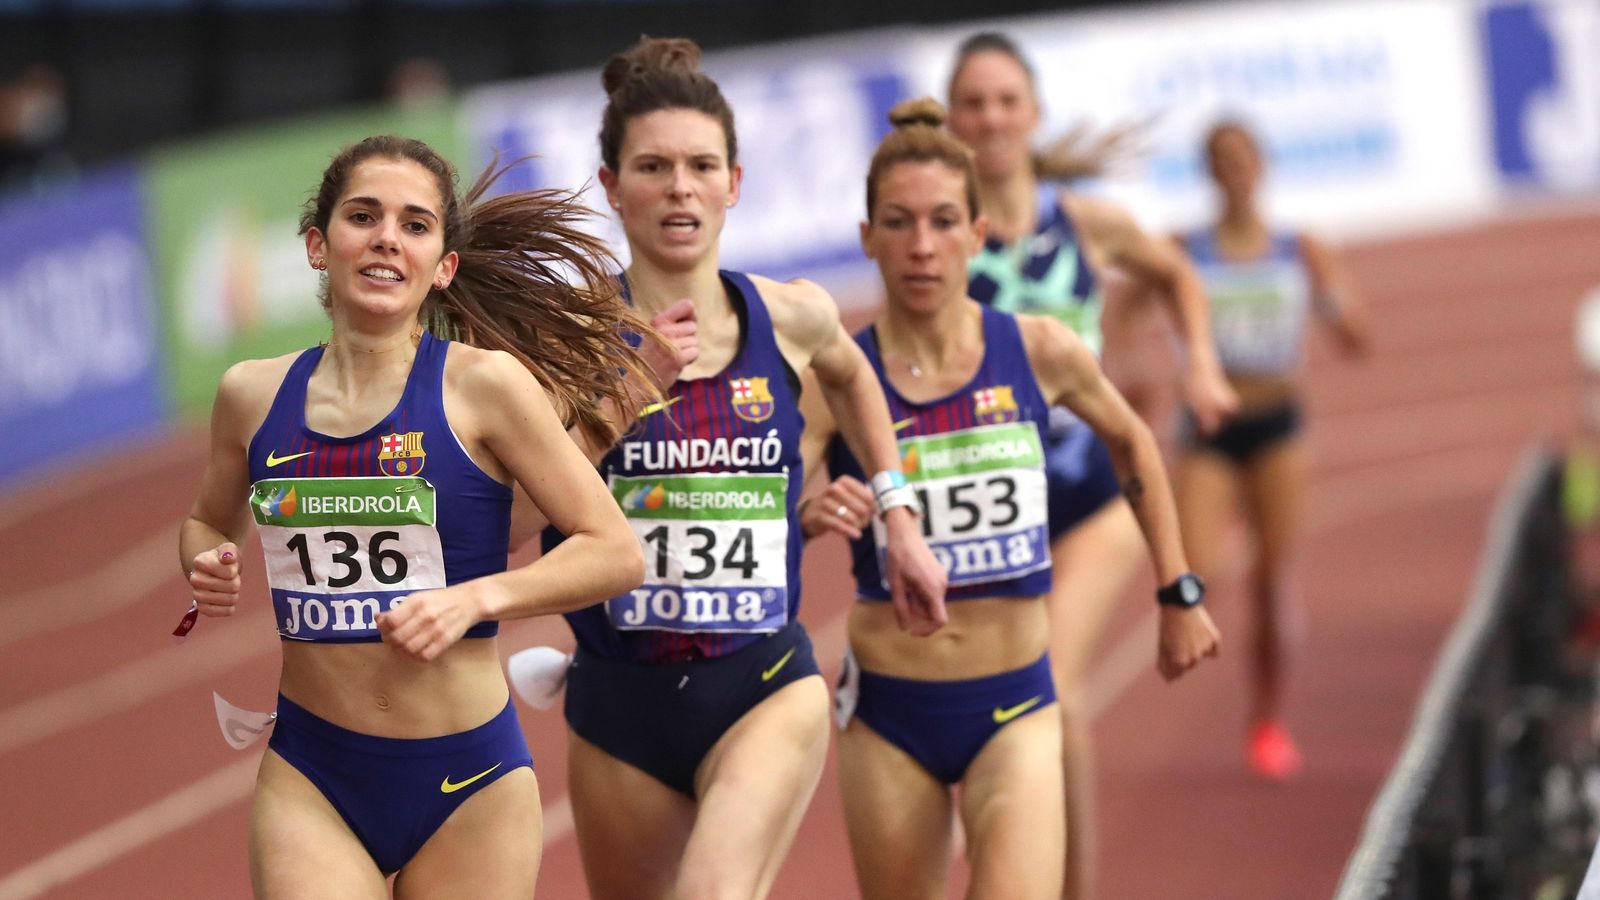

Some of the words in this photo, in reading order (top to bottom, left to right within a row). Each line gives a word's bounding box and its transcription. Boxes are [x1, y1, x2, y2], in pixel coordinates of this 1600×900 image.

[624, 428, 782, 471] FUNDACIÓ
[301, 495, 423, 515] IBERDROLA
[668, 490, 776, 510] IBERDROLA
[914, 475, 1019, 538] 153
[286, 531, 408, 588] 136
[644, 525, 759, 580] 134
